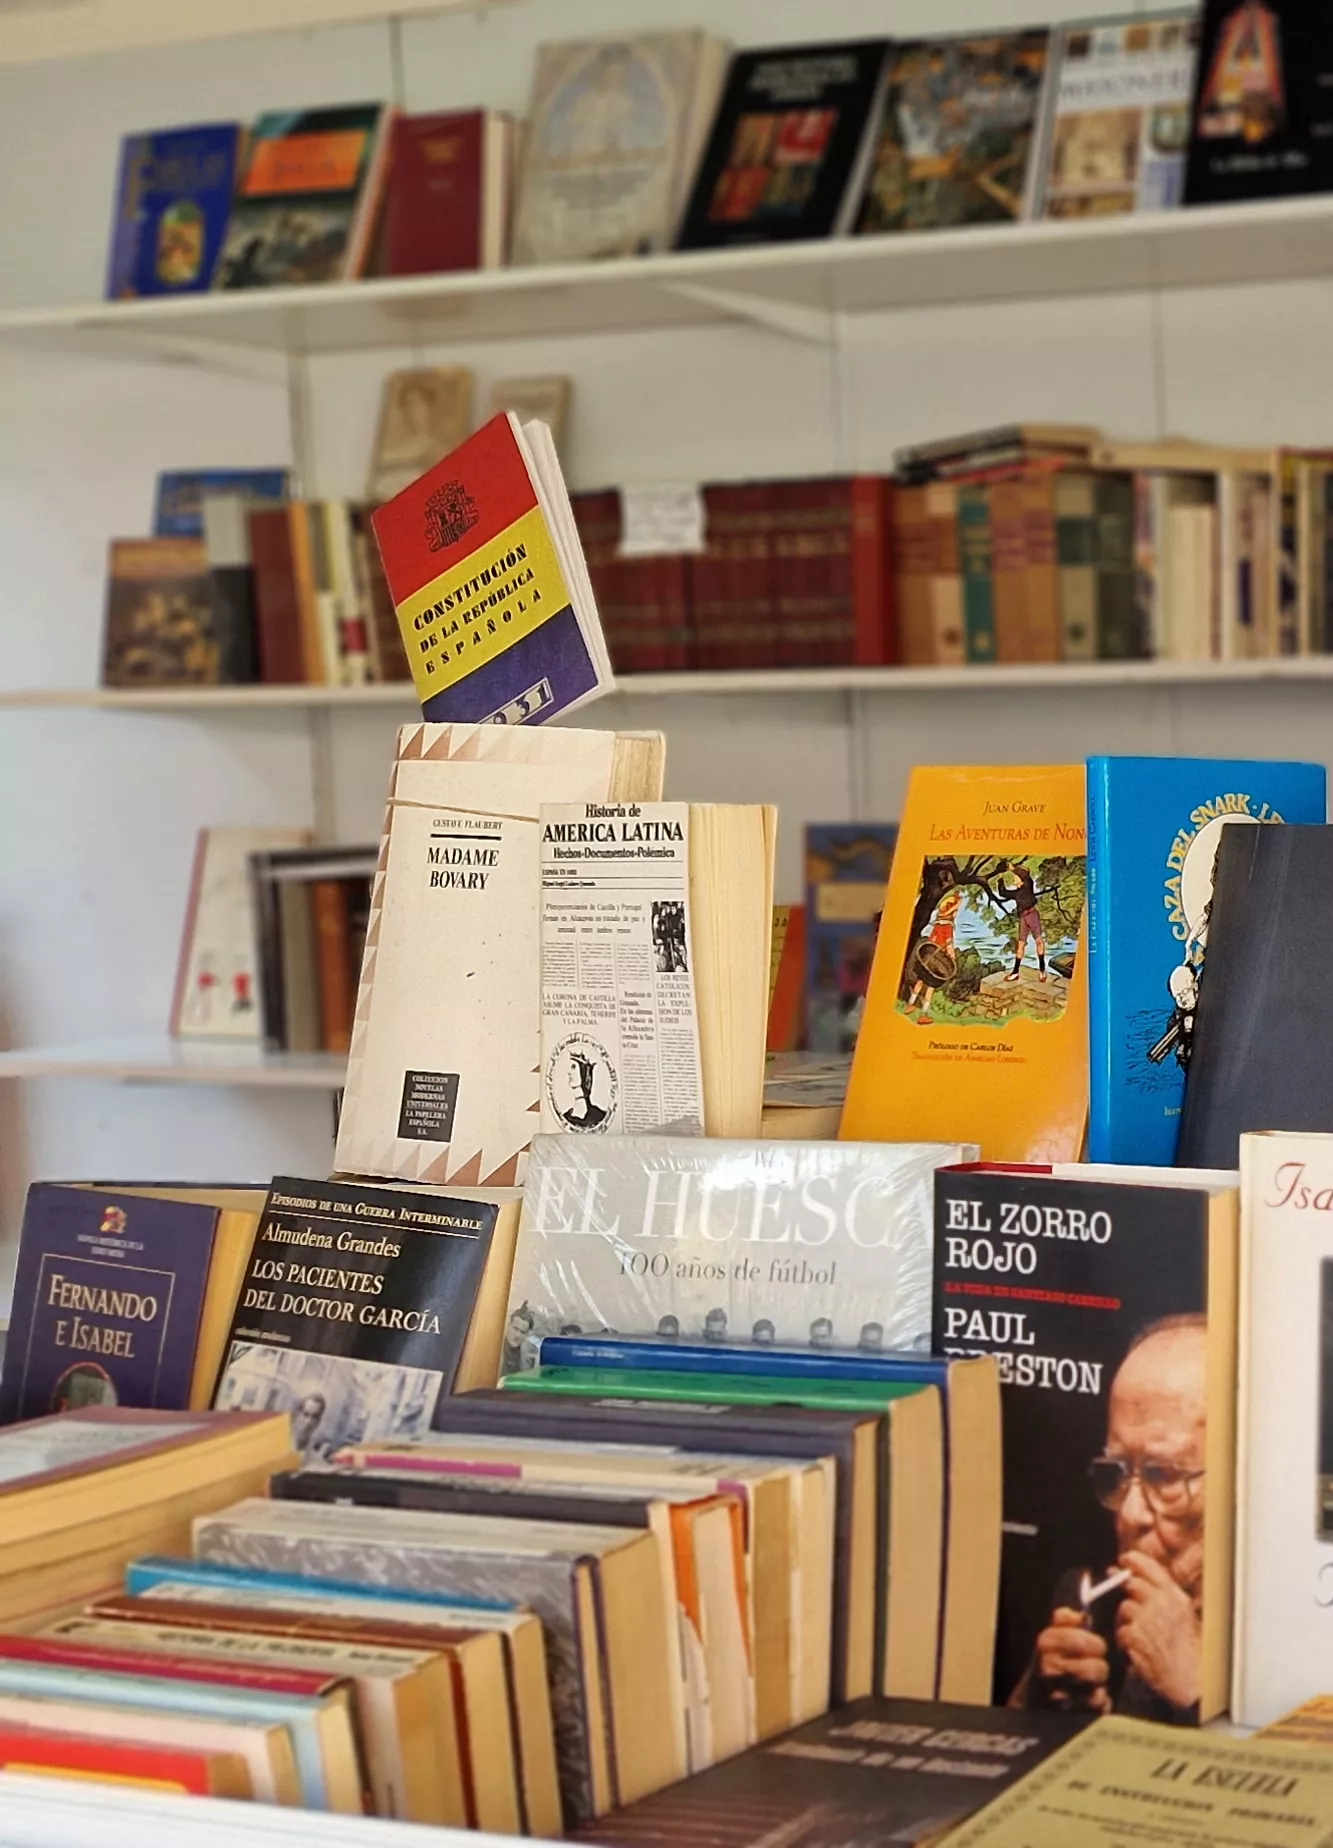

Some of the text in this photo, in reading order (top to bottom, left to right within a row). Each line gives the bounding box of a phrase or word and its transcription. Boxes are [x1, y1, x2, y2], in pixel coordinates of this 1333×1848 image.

[413, 543, 528, 632] CONSTITUCIÓN
[419, 566, 536, 653] DE LA REPÚBLICA
[464, 819, 503, 831] FLAUBERT
[585, 803, 641, 819] Historia de
[541, 821, 685, 844] AMERICA LATINA
[426, 846, 500, 868] MADAME
[1163, 792, 1252, 942] CAZA DEL SNARK
[428, 870, 490, 891] BOVARY
[529, 1164, 622, 1239] EL
[945, 1198, 1113, 1244] EL ZORRO
[261, 1221, 402, 1259] Almudena Grandes
[944, 1236, 1038, 1275] ROJO
[251, 1258, 385, 1296] LOS PACIENTES
[619, 1250, 838, 1287] 100 años de fútbol
[47, 1273, 158, 1323] FERNANDO
[243, 1288, 442, 1336] DEL DOCTOR GARCÍA
[69, 1315, 136, 1359] ISABEL
[943, 1307, 1036, 1346] PAUL
[1150, 1756, 1191, 1782] LA
